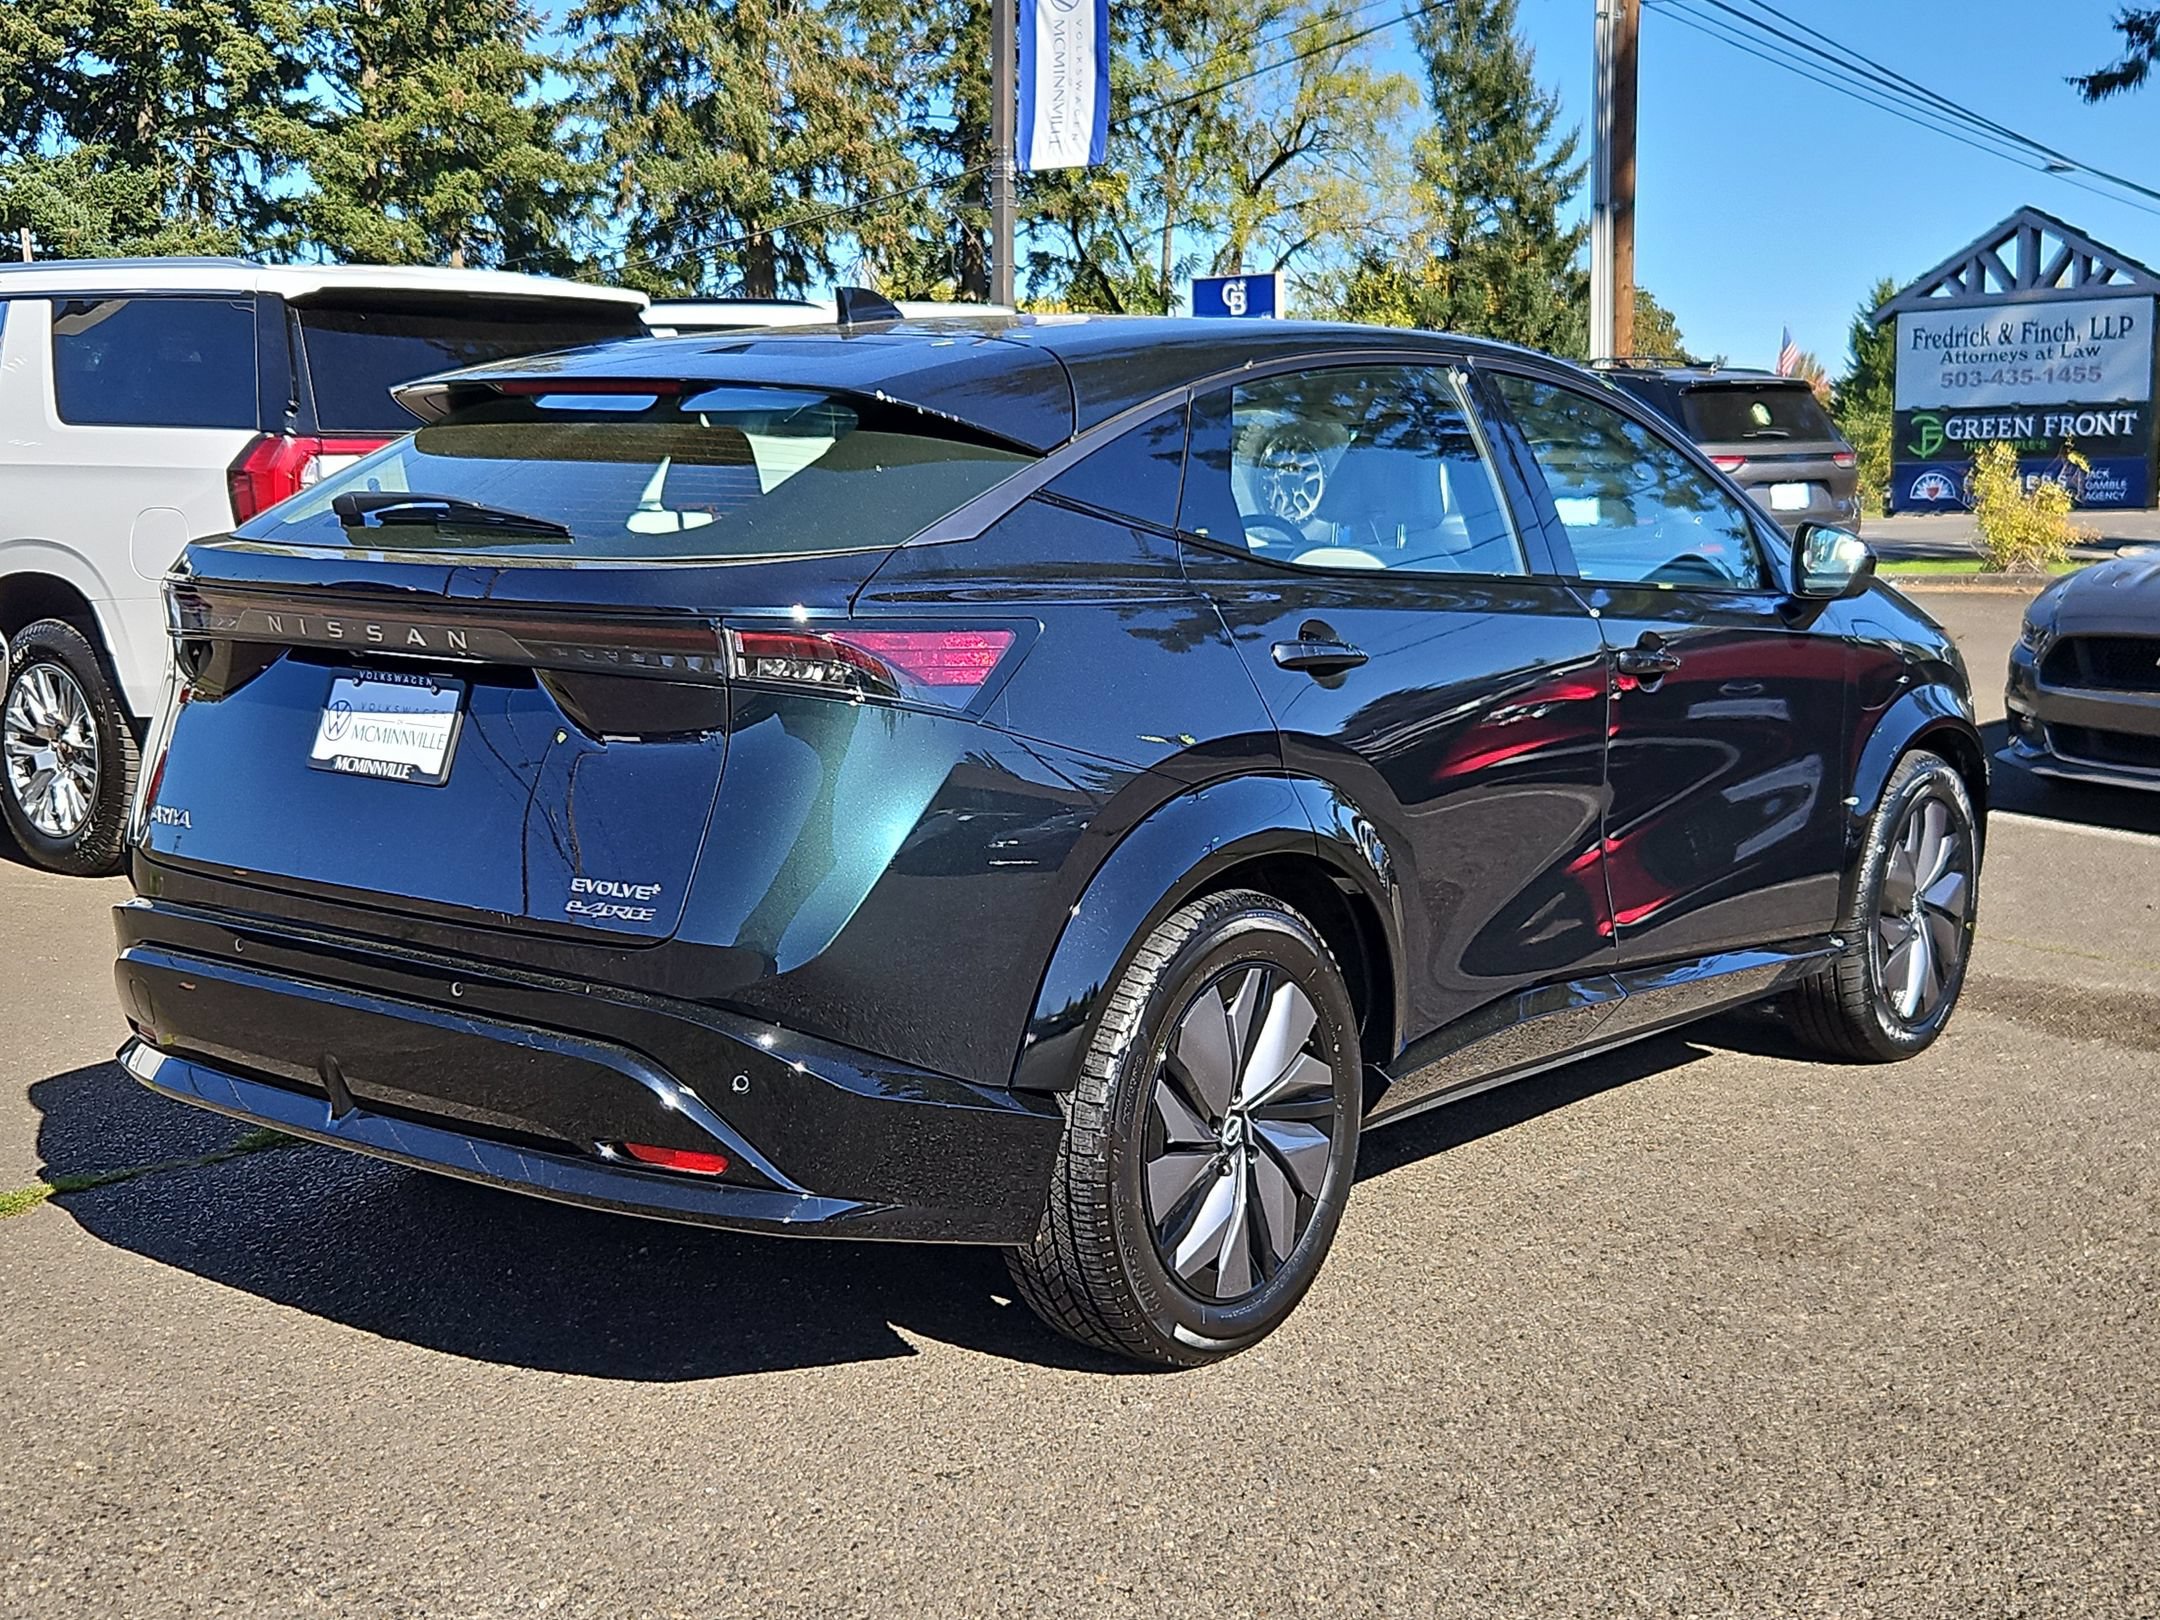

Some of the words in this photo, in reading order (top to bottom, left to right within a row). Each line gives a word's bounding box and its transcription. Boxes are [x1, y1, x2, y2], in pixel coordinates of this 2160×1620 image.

[1911, 322, 1991, 350] Fredrick
[1998, 321, 2014, 346] &
[2020, 316, 2081, 346] Finch,
[2089, 315, 2134, 341] LLP
[1940, 348, 2028, 366] Attorneys
[2035, 346, 2053, 361] at
[2060, 343, 2102, 359] Law
[1940, 365, 2102, 389] 503-435-1455
[1945, 413, 2036, 440] GREEN
[2043, 410, 2139, 438] FRONT
[267, 614, 467, 650] NISSAN
[359, 670, 433, 686] VOLKSWAGEN
[351, 723, 447, 751] MCMINNVILLE
[334, 755, 413, 779] MCMINNVILLE
